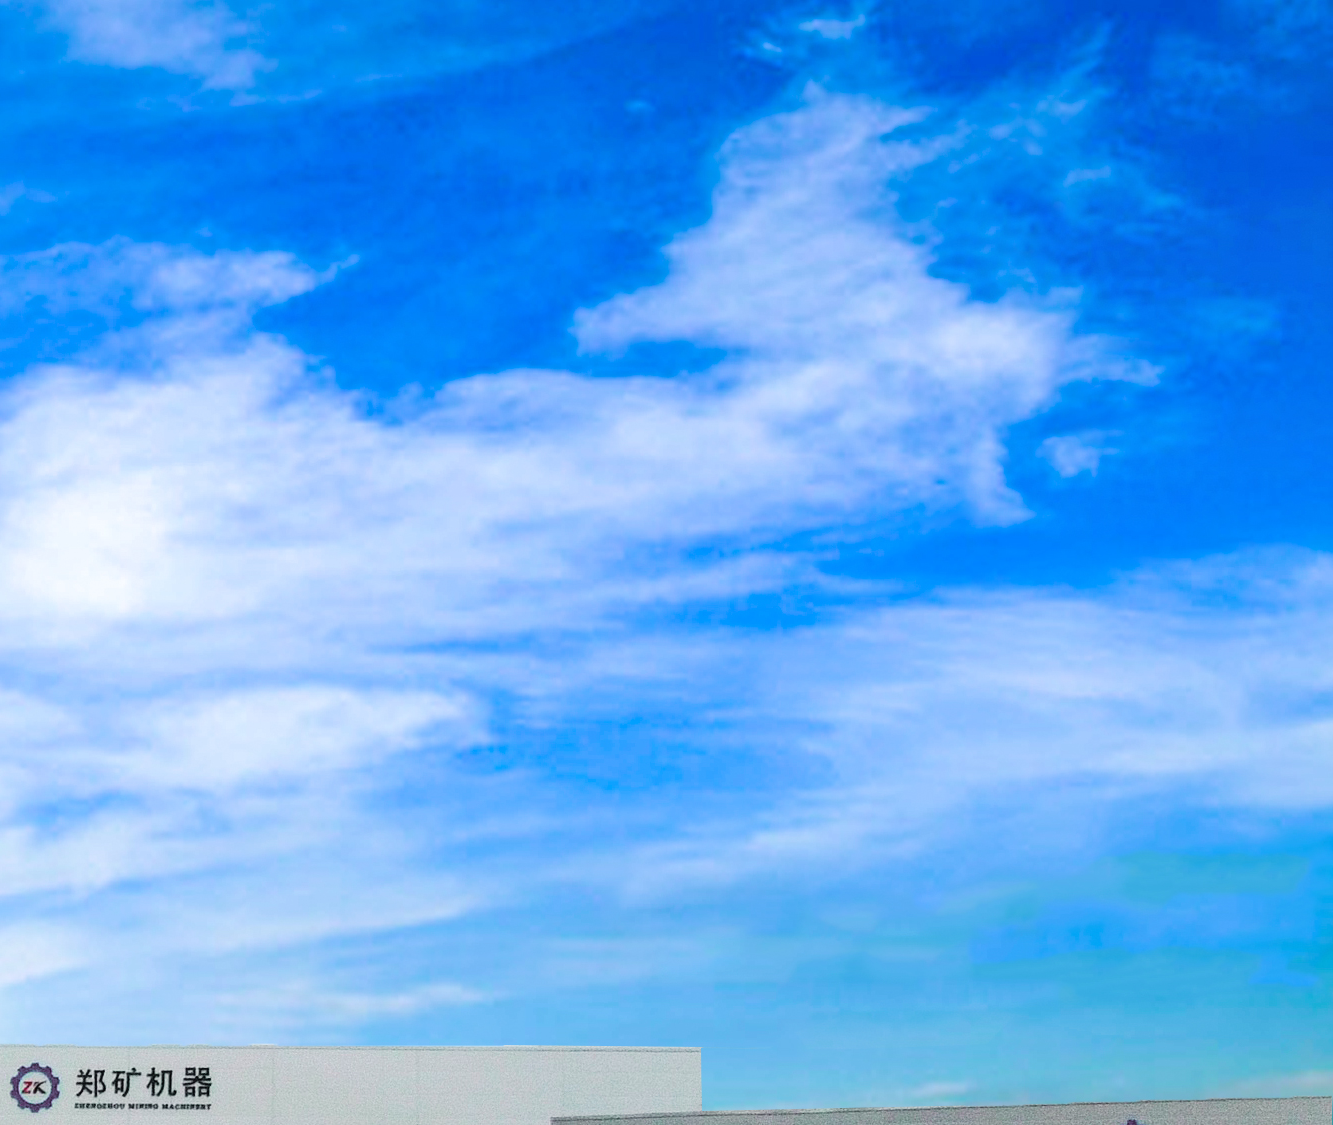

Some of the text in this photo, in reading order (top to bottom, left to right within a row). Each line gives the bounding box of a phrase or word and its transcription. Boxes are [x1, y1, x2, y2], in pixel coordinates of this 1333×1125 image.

[20, 1080, 47, 1095] ZK
[76, 1067, 212, 1097] 郑矿机器
[74, 1102, 126, 1110] ZHENGZHOU
[161, 1103, 212, 1111] MACHINERY
